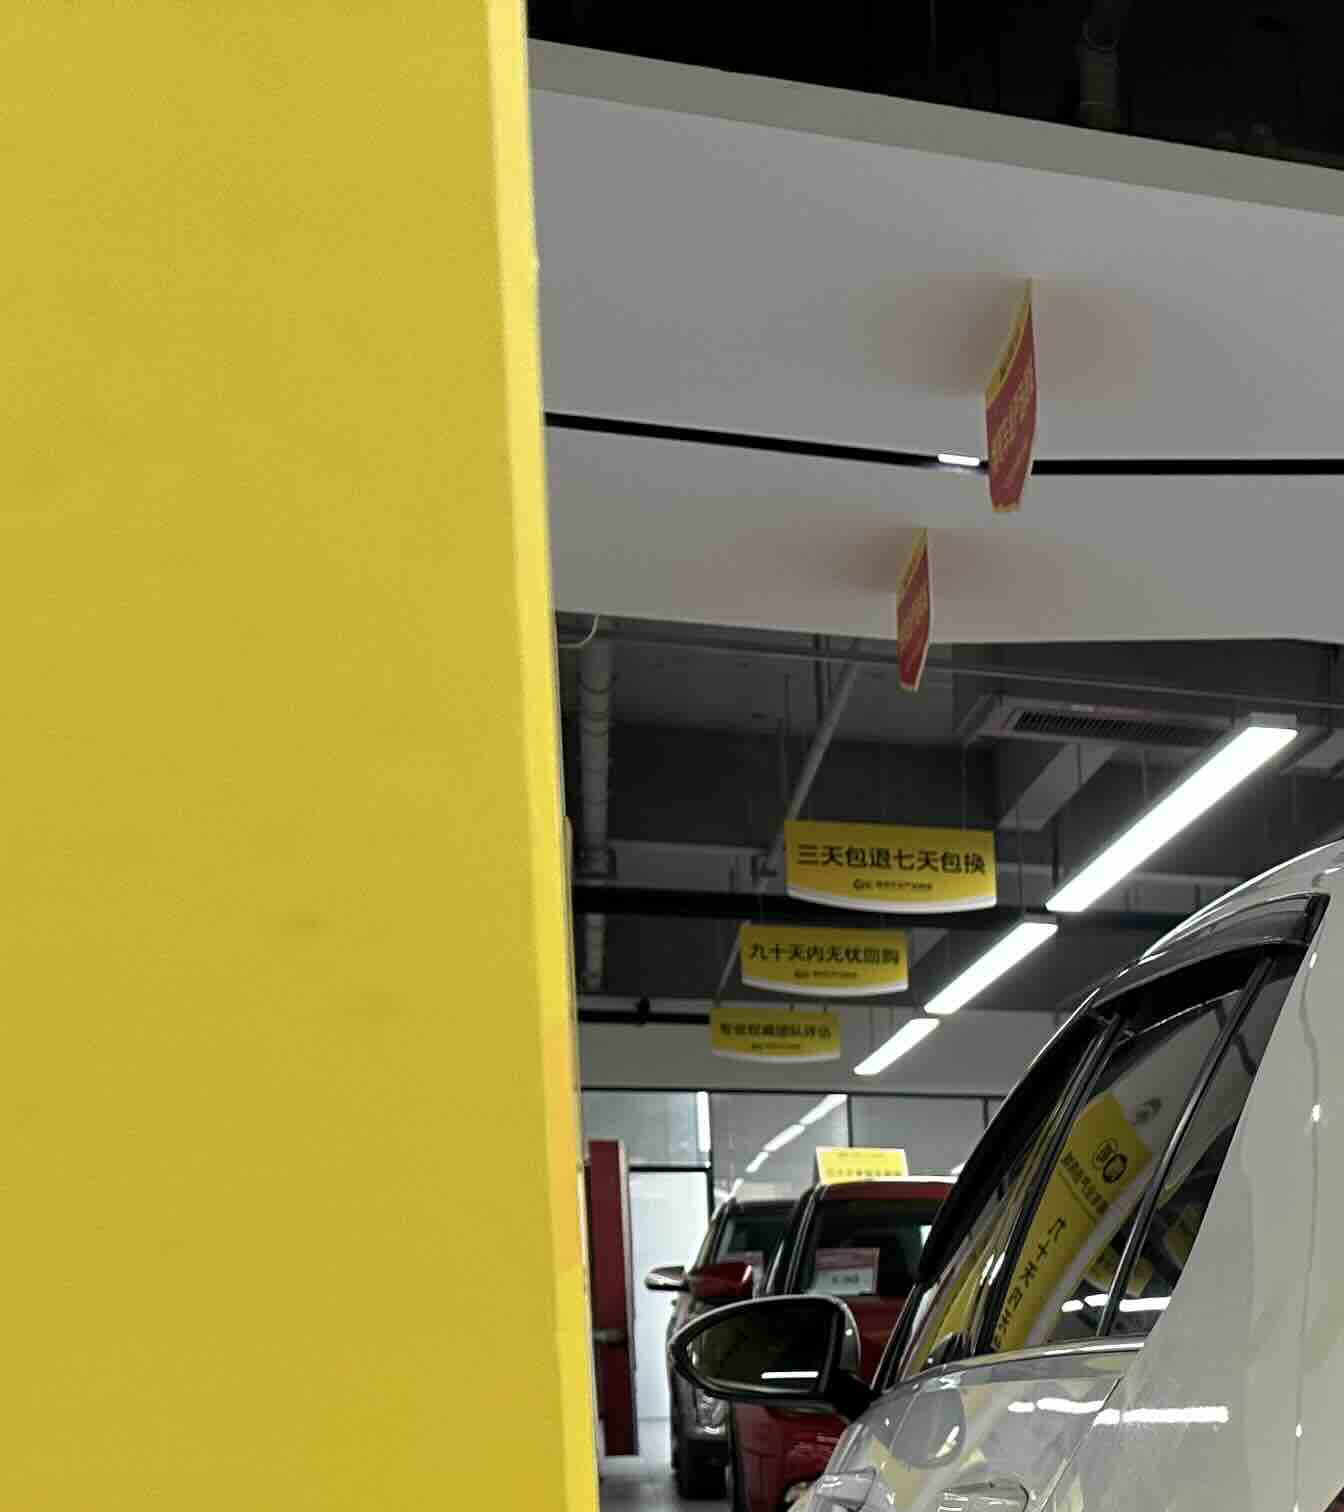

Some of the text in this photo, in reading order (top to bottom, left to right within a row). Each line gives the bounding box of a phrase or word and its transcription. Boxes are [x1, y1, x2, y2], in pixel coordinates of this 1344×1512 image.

[796, 844, 985, 875] 三天包退七天包换
